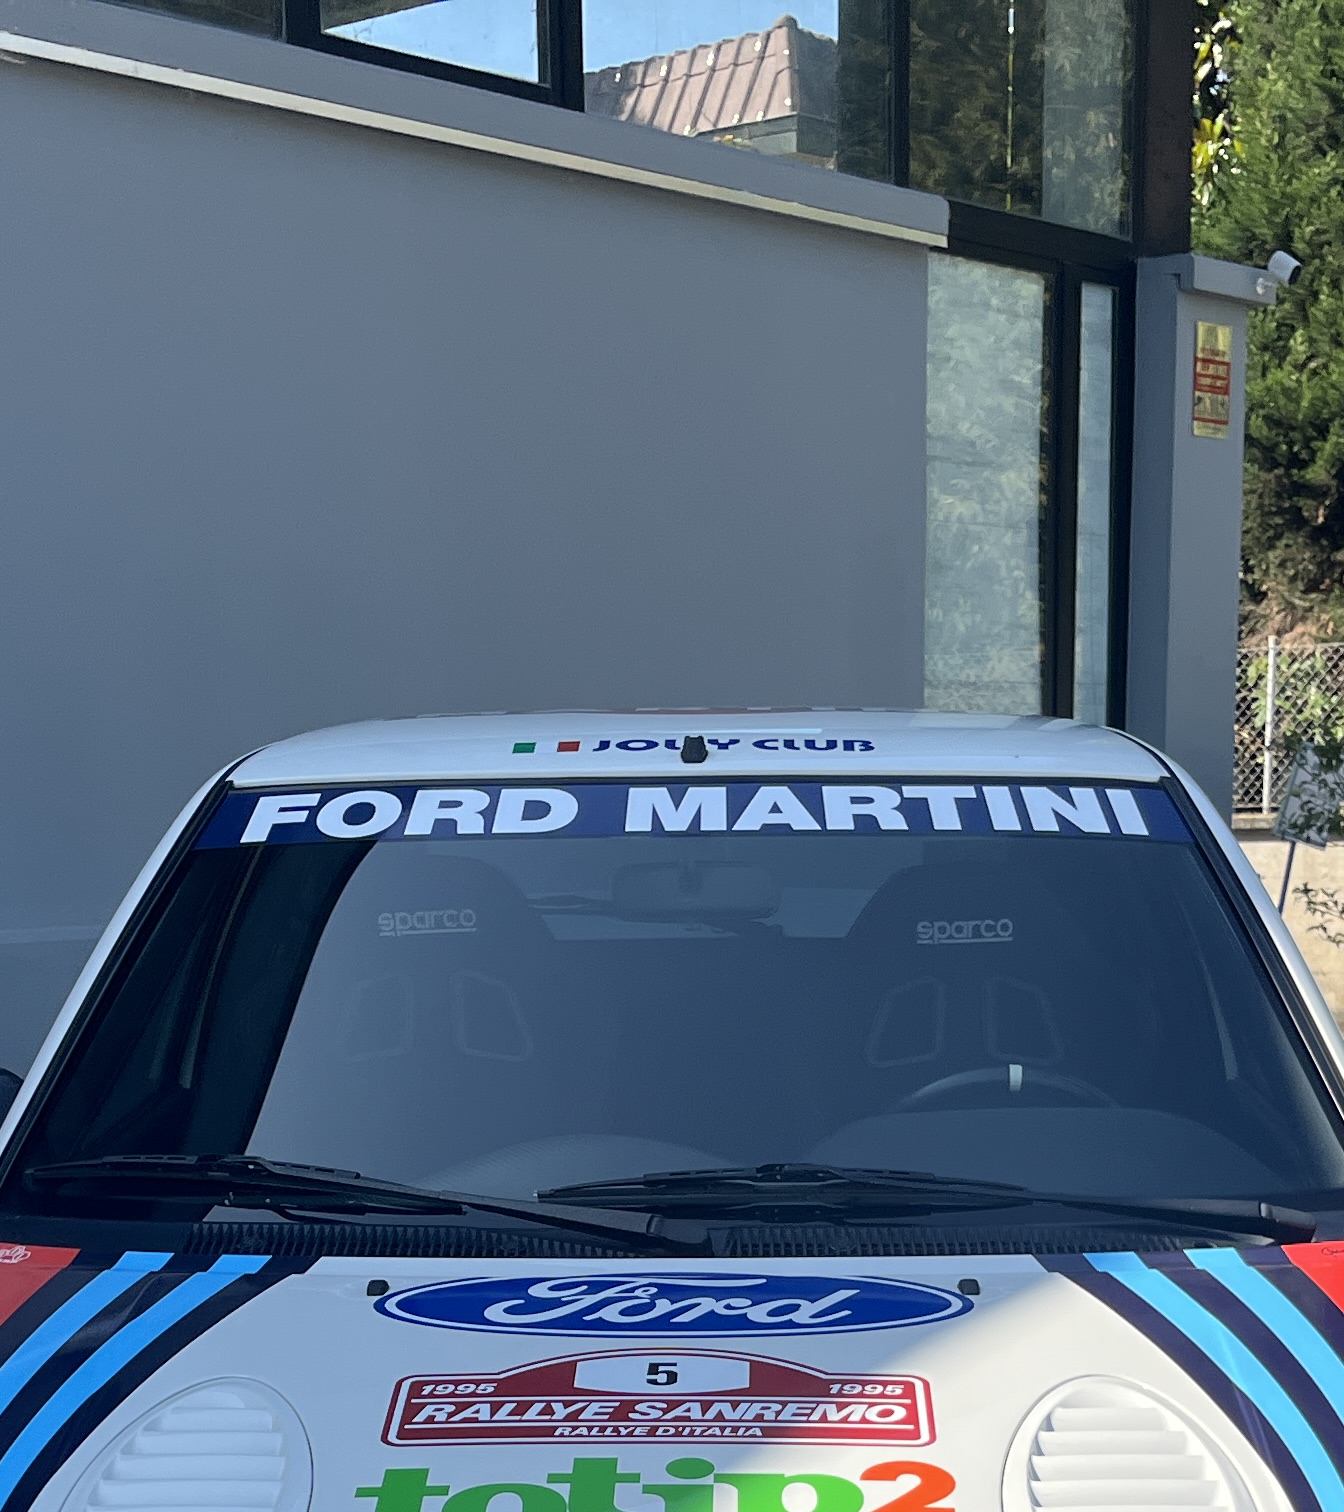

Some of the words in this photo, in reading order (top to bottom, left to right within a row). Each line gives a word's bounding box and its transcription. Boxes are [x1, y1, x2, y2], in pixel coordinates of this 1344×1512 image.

[592, 738, 741, 753] JOLY
[751, 738, 876, 752] CLUB
[239, 786, 579, 844] FORD
[623, 784, 1150, 837] MARTINI
[377, 906, 477, 937] sparco
[915, 916, 1014, 942] sparco
[484, 1277, 861, 1326] Ford
[645, 1361, 679, 1387] 5
[419, 1382, 499, 1397] 1995
[827, 1381, 905, 1397] 1995
[410, 1401, 628, 1424] RALLYE
[629, 1401, 909, 1423] SANREMO
[553, 1425, 668, 1438] RALLYE
[670, 1425, 764, 1438] D'ITALIA
